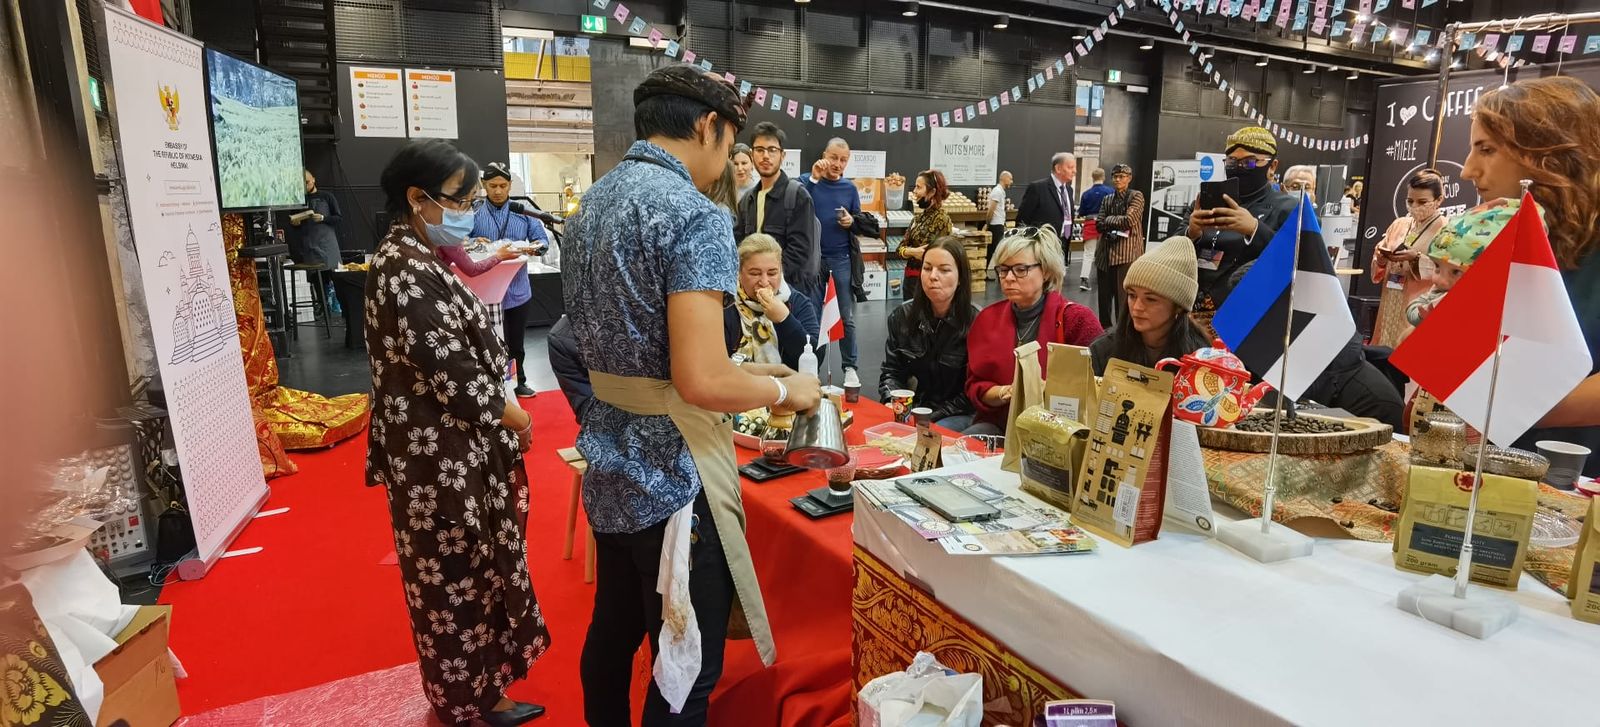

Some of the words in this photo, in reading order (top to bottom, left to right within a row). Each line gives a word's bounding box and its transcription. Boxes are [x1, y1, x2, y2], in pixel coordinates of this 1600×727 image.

[1386, 102, 1397, 127] I
[944, 144, 962, 156] NUTS
[969, 145, 985, 156] MORE
[1386, 139, 1418, 161] #MIELE
[1443, 183, 1460, 198] CUP
